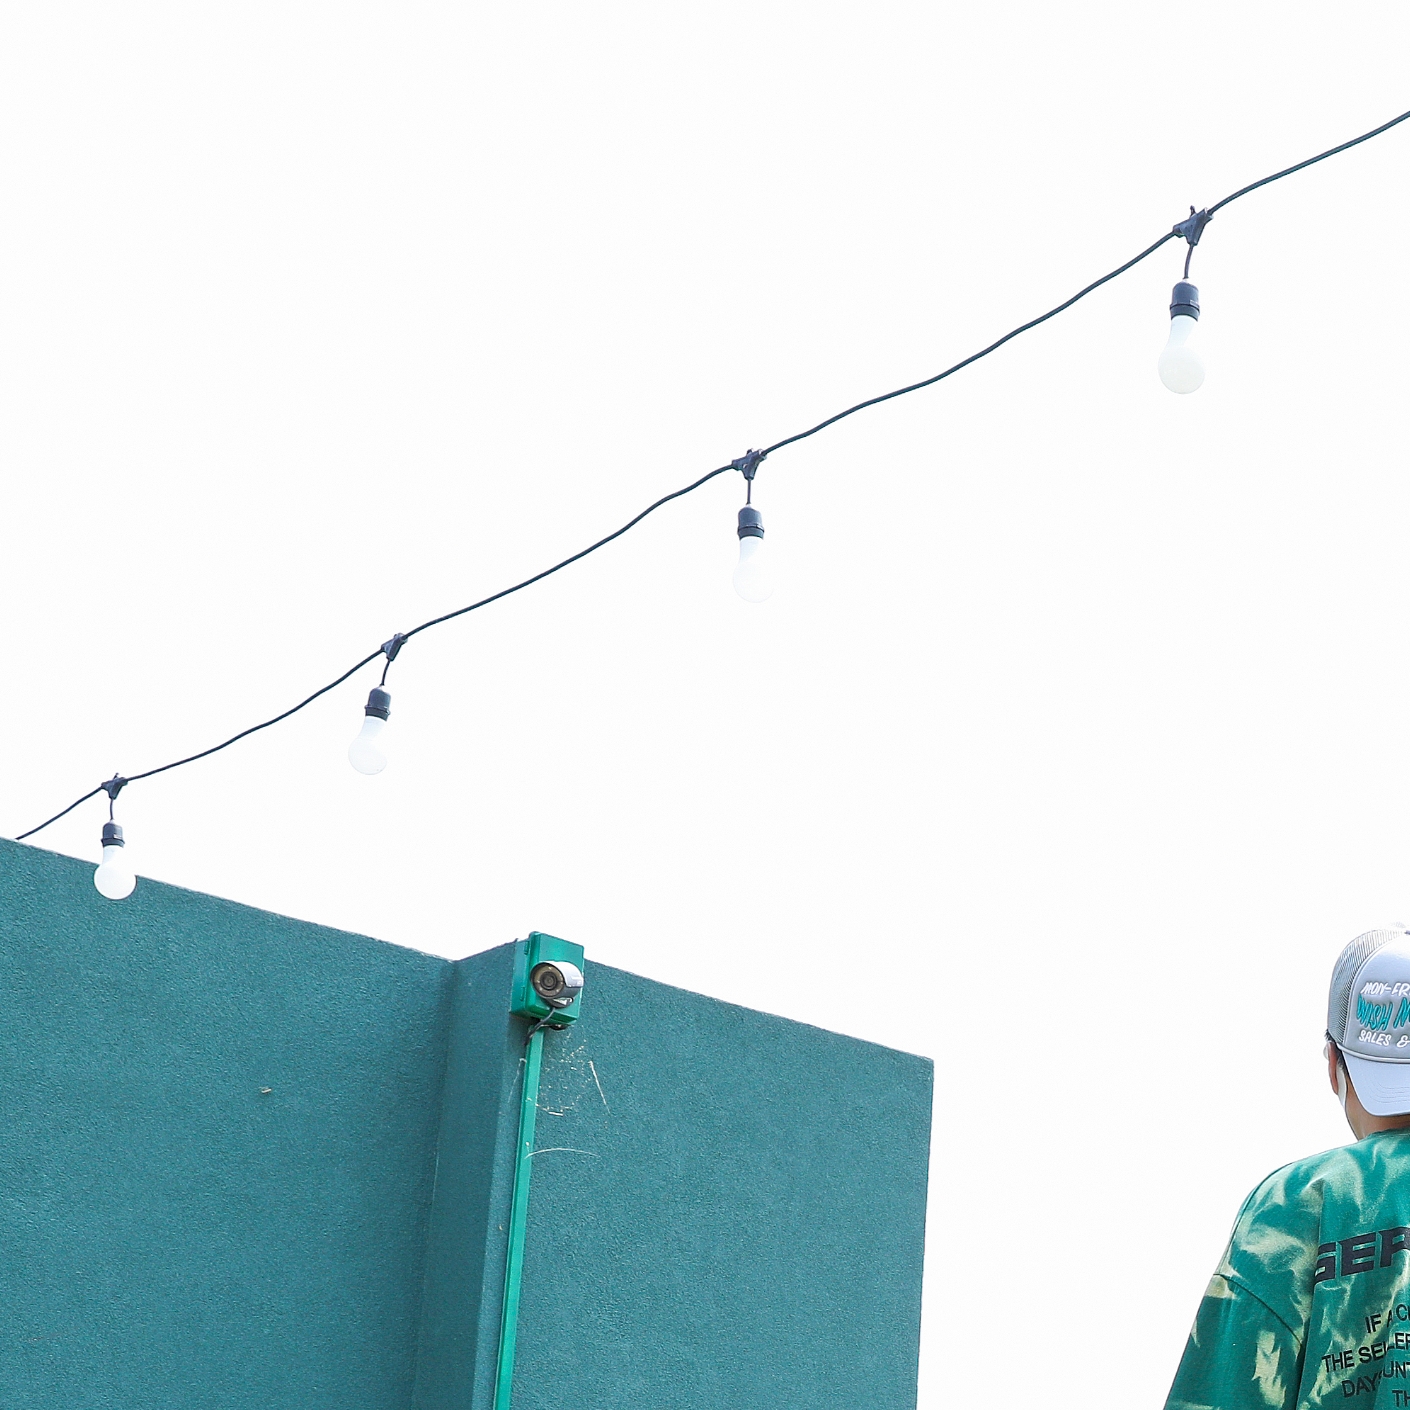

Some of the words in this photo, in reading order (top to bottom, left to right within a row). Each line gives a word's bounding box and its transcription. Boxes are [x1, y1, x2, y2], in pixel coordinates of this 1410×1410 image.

[1356, 994, 1393, 1031] WISH
[1359, 1030, 1391, 1046] SALES
[1397, 1035, 1410, 1047] &
[1364, 1313, 1381, 1333] IF
[1322, 1349, 1354, 1372] THE
